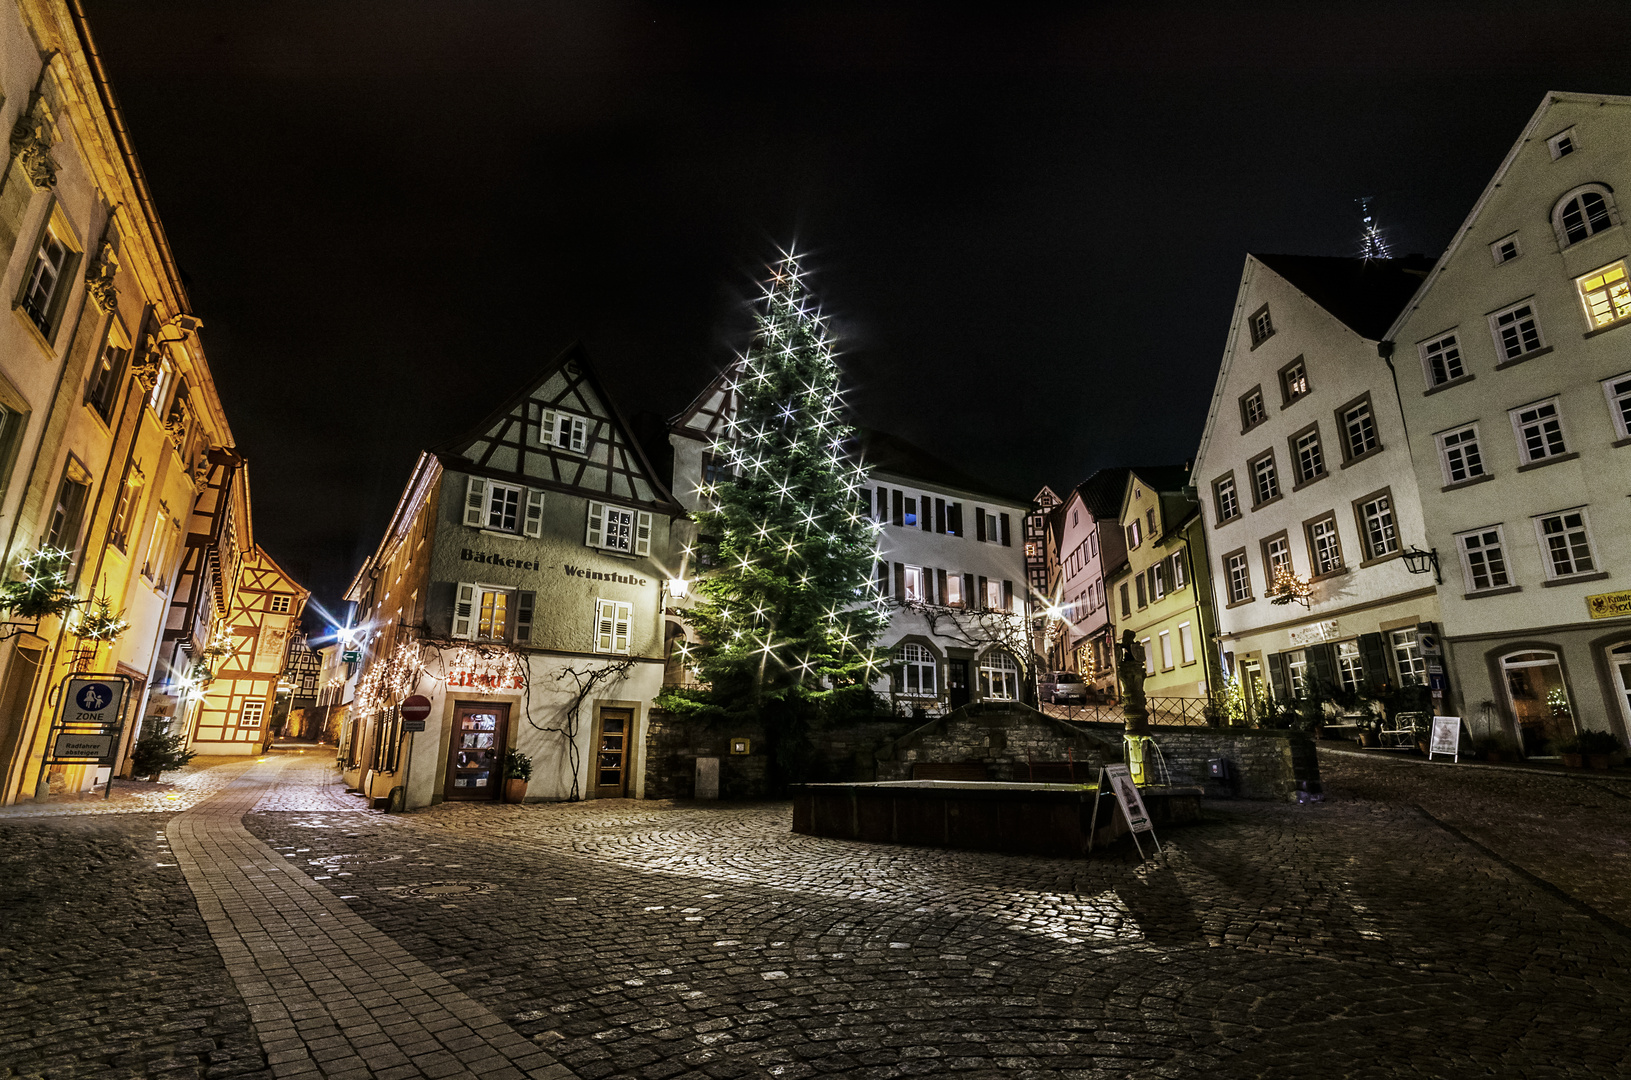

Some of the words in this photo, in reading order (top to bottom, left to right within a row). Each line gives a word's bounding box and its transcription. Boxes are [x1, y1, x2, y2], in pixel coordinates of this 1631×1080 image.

[460, 548, 540, 571] Bäckerei
[563, 564, 647, 587] Weinstube
[76, 712, 104, 720] ZONE
